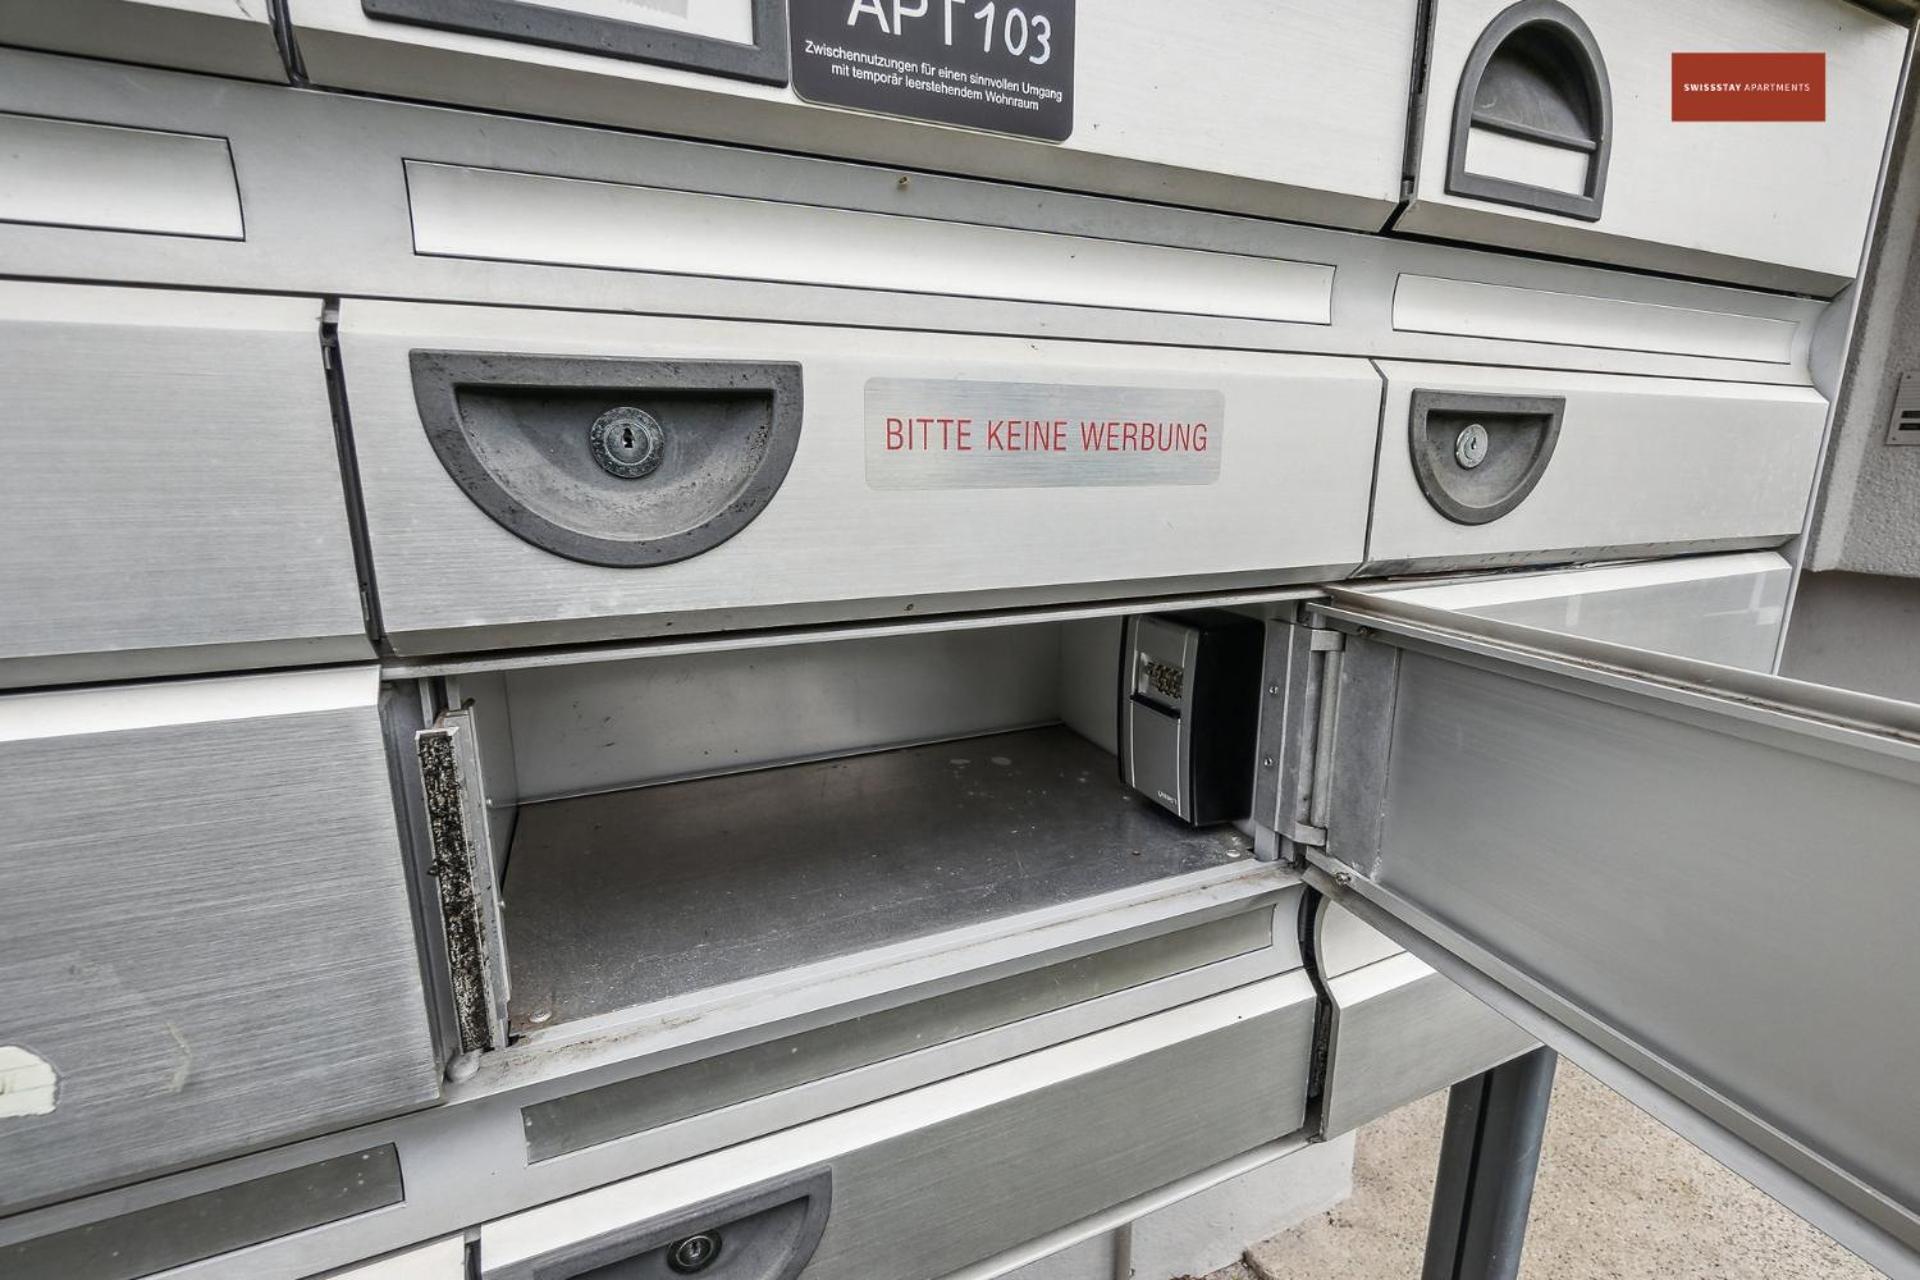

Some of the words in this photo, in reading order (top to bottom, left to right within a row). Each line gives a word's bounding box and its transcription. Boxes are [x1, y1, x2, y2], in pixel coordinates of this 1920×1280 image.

[847, 0, 966, 46] APT
[974, 1, 1051, 65] 103
[805, 39, 918, 73] Zwischennutzungen
[920, 62, 937, 77] für
[938, 66, 968, 82] einen
[969, 73, 1020, 92] sinnvollen
[1022, 82, 1063, 103] Umgang
[831, 63, 850, 77] mit
[852, 66, 903, 86] temporär
[905, 75, 983, 100] leerstehendem
[984, 90, 1039, 111] Wohnraum
[885, 417, 972, 451] BITTE
[987, 420, 1068, 452] KEINE
[1080, 422, 1208, 452] WERBUNG
